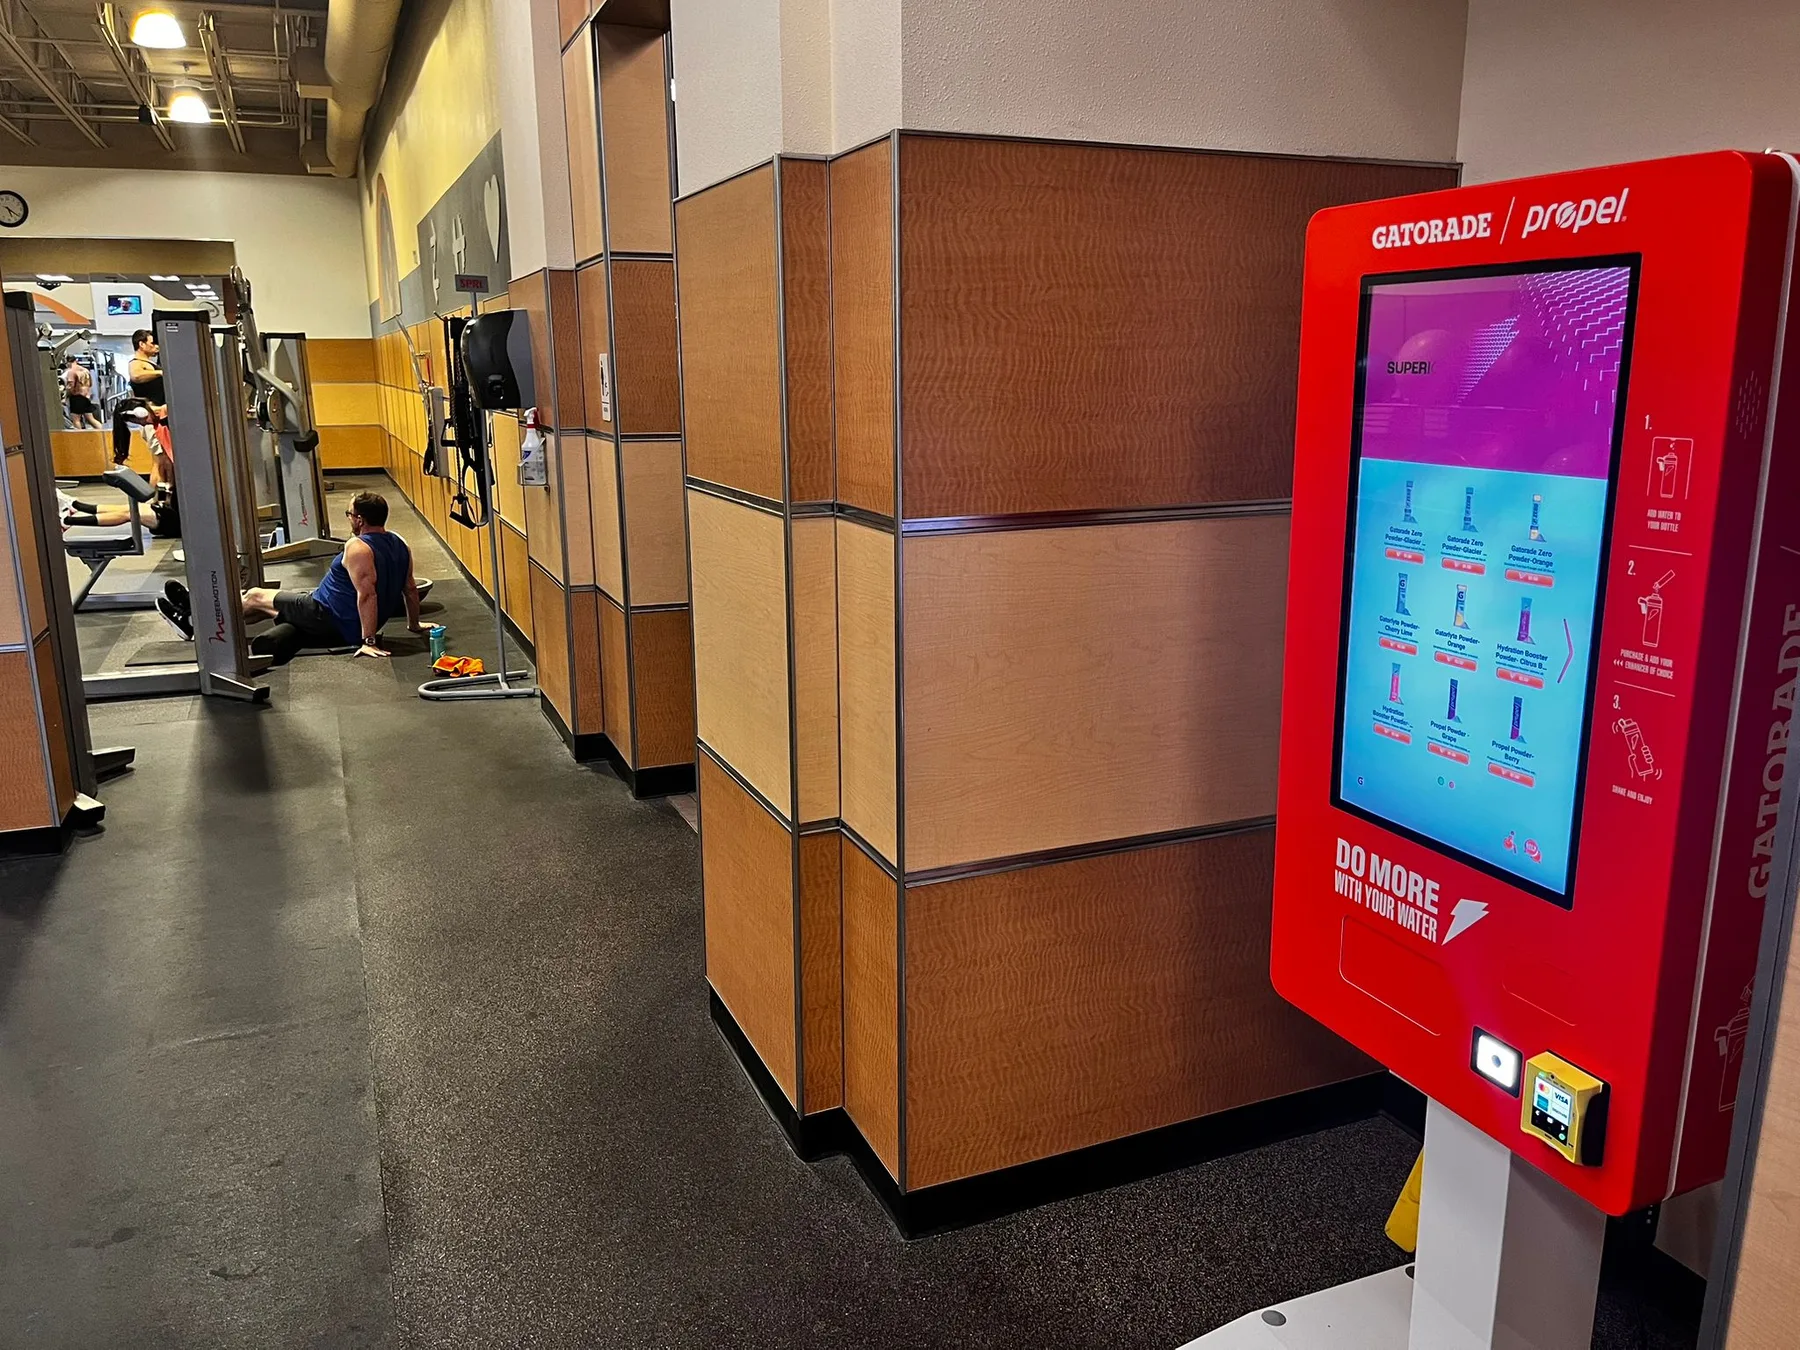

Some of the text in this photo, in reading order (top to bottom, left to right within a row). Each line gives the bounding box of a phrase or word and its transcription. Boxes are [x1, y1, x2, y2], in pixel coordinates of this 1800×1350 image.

[1371, 188, 1629, 250] GATORADE propel
[1645, 414, 1653, 430] 1.
[1389, 526, 1423, 538] Gatorade Zero
[1660, 522, 1679, 533] BOTTLE
[1447, 535, 1484, 547] Gatorade Zero
[1441, 543, 1482, 555] Powder-Glacier
[1511, 544, 1553, 558] Gatorade Zero
[1508, 553, 1553, 568] Powder-Orange
[1627, 560, 1636, 576] 2.
[211, 570, 222, 622] FREEMOTION
[1384, 625, 1400, 636] Cherry
[1401, 628, 1413, 637] Lime
[1400, 619, 1420, 630] Powder-
[1447, 640, 1466, 651] Orange
[1458, 634, 1480, 645] Powder-
[1495, 652, 1518, 663] Powder-
[1520, 658, 1537, 668] Citrus
[1496, 643, 1548, 662] Hydration Booster
[1612, 694, 1621, 710] 3.
[1382, 705, 1404, 717] Hydration
[1430, 720, 1446, 732] Propel
[1447, 725, 1466, 737] Powder
[1441, 732, 1457, 743] Grape
[1491, 740, 1534, 759] Propel Powder-
[1748, 603, 1800, 900] GATORADE
[1504, 753, 1520, 765] Berry
[1335, 837, 1440, 915] DO MORE
[1334, 869, 1438, 944] WITH YOUR WATER
[1554, 1091, 1569, 1106] VISA
